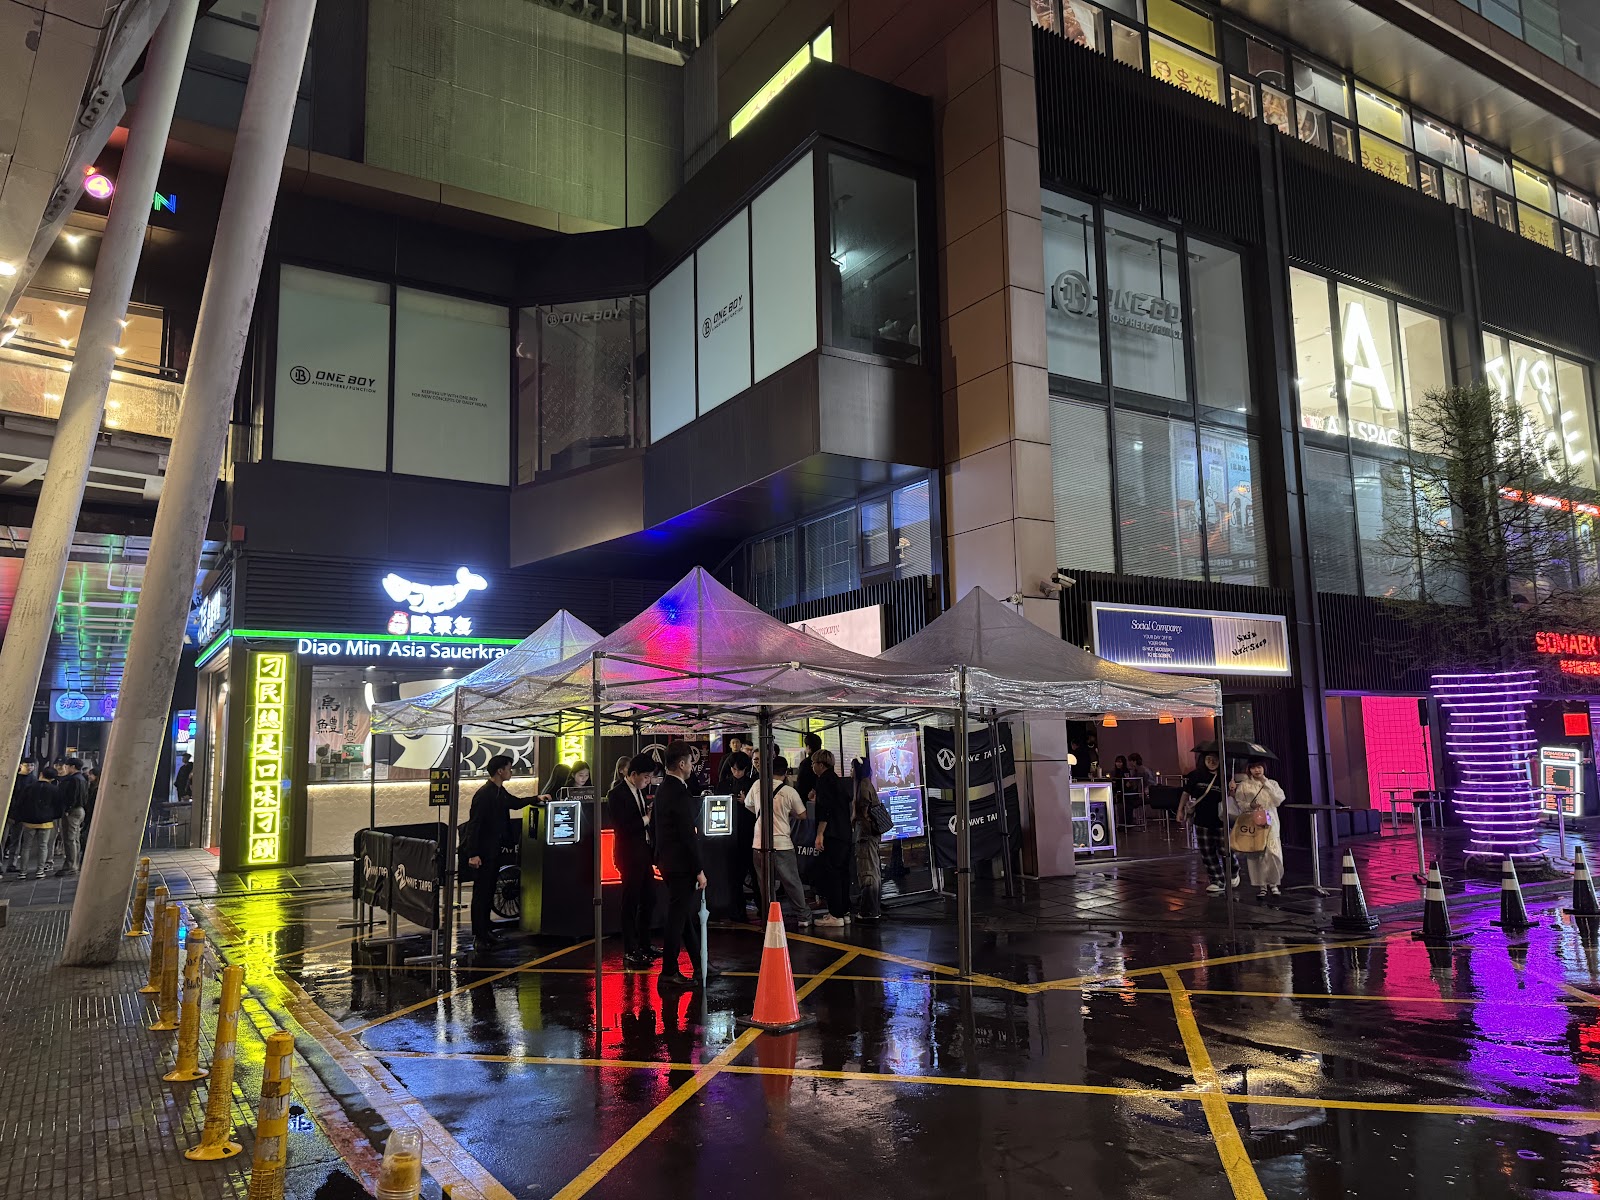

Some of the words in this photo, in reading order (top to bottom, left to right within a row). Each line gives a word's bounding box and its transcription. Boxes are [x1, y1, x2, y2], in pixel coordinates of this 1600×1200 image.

[87, 177, 110, 196] 4
[728, 294, 743, 313] BOY
[562, 312, 591, 324] ONE
[593, 308, 622, 321] BOY
[1343, 301, 1394, 411] A
[316, 370, 346, 383] ONE
[348, 376, 376, 387] BOY
[1131, 619, 1151, 630] Social
[298, 638, 341, 656] Diao
[345, 640, 380, 656] Min
[388, 641, 426, 658] Asia
[1536, 631, 1598, 656] SOMAEK
[252, 656, 283, 861] 刁民總是口味刁鑽
[1240, 825, 1257, 834] GU
